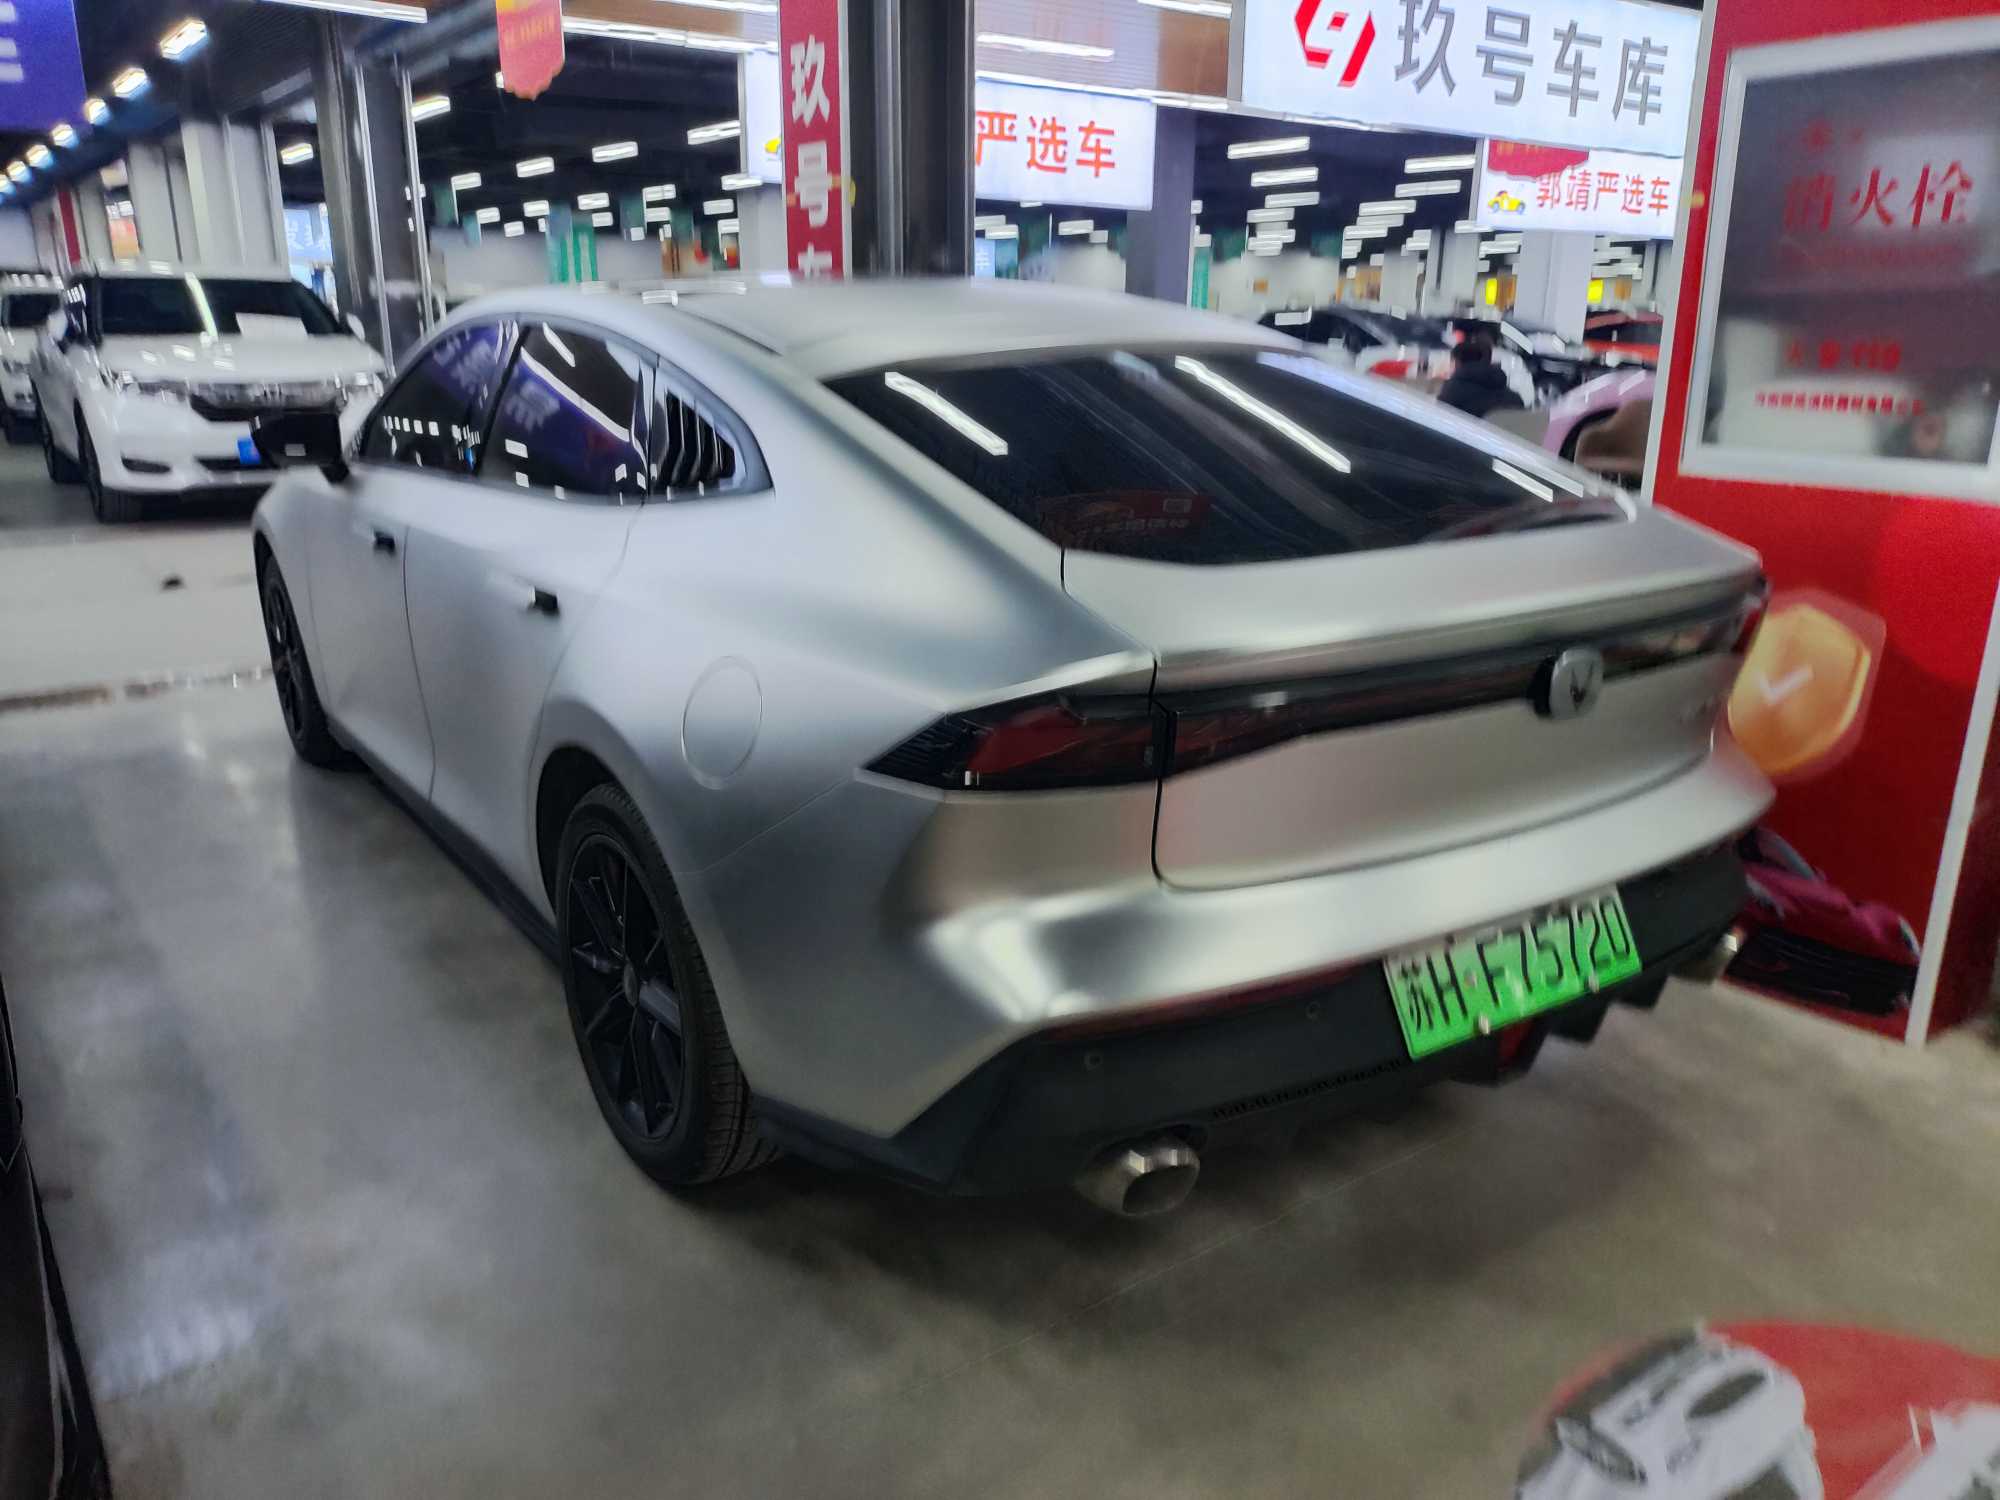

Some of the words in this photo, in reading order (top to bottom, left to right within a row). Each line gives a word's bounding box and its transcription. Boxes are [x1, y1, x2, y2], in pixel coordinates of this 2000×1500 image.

[1394, 0, 1668, 126] 玖号车库
[975, 110, 1116, 178] 严选车
[1536, 163, 1670, 216] 郭靖严选车
